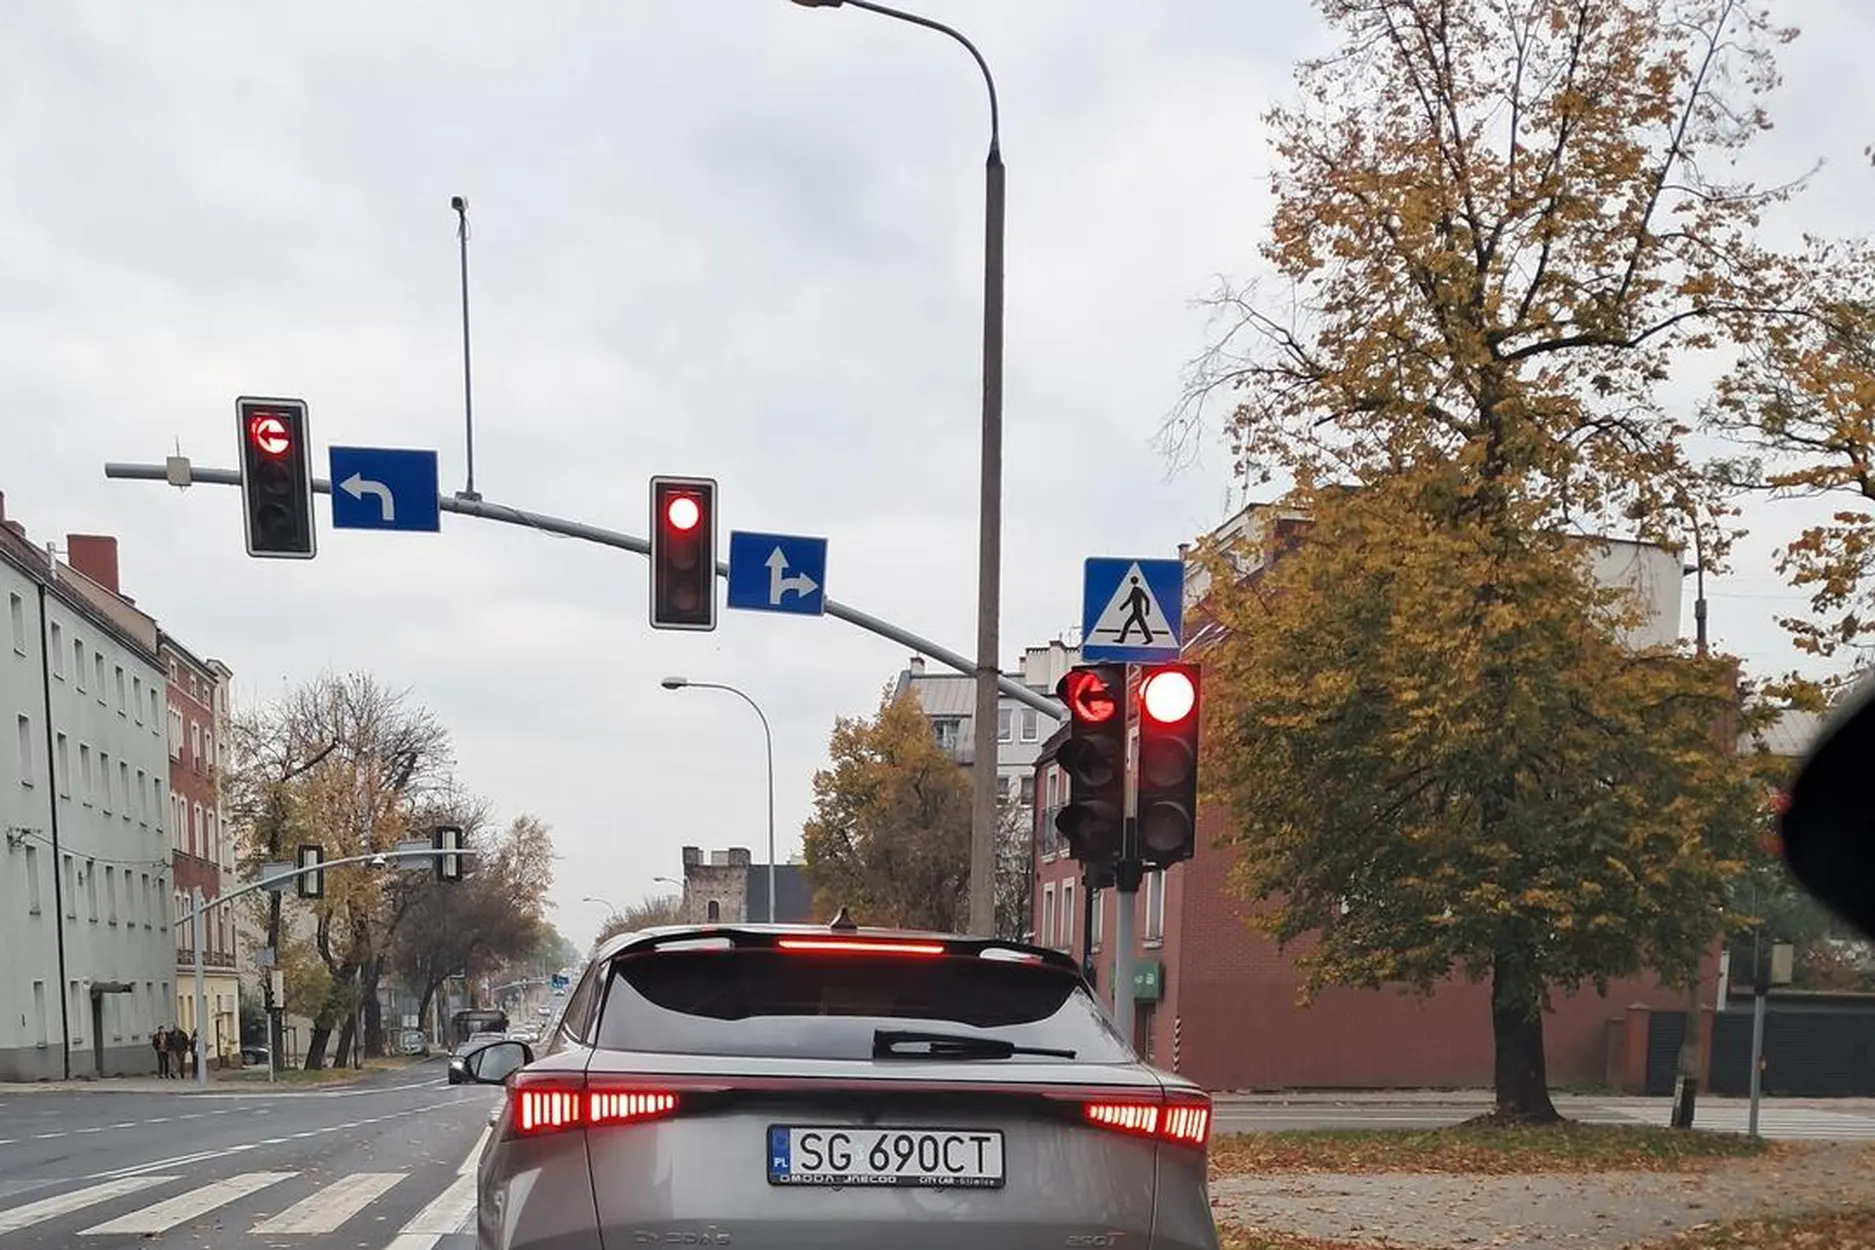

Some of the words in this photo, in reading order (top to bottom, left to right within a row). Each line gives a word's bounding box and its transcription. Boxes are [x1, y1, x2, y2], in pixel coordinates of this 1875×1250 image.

[799, 1133, 852, 1171] SG
[868, 1134, 992, 1174] 690CT
[773, 1158, 789, 1168] PL
[780, 1173, 834, 1183] OMODA
[843, 1174, 897, 1184] JAECOO
